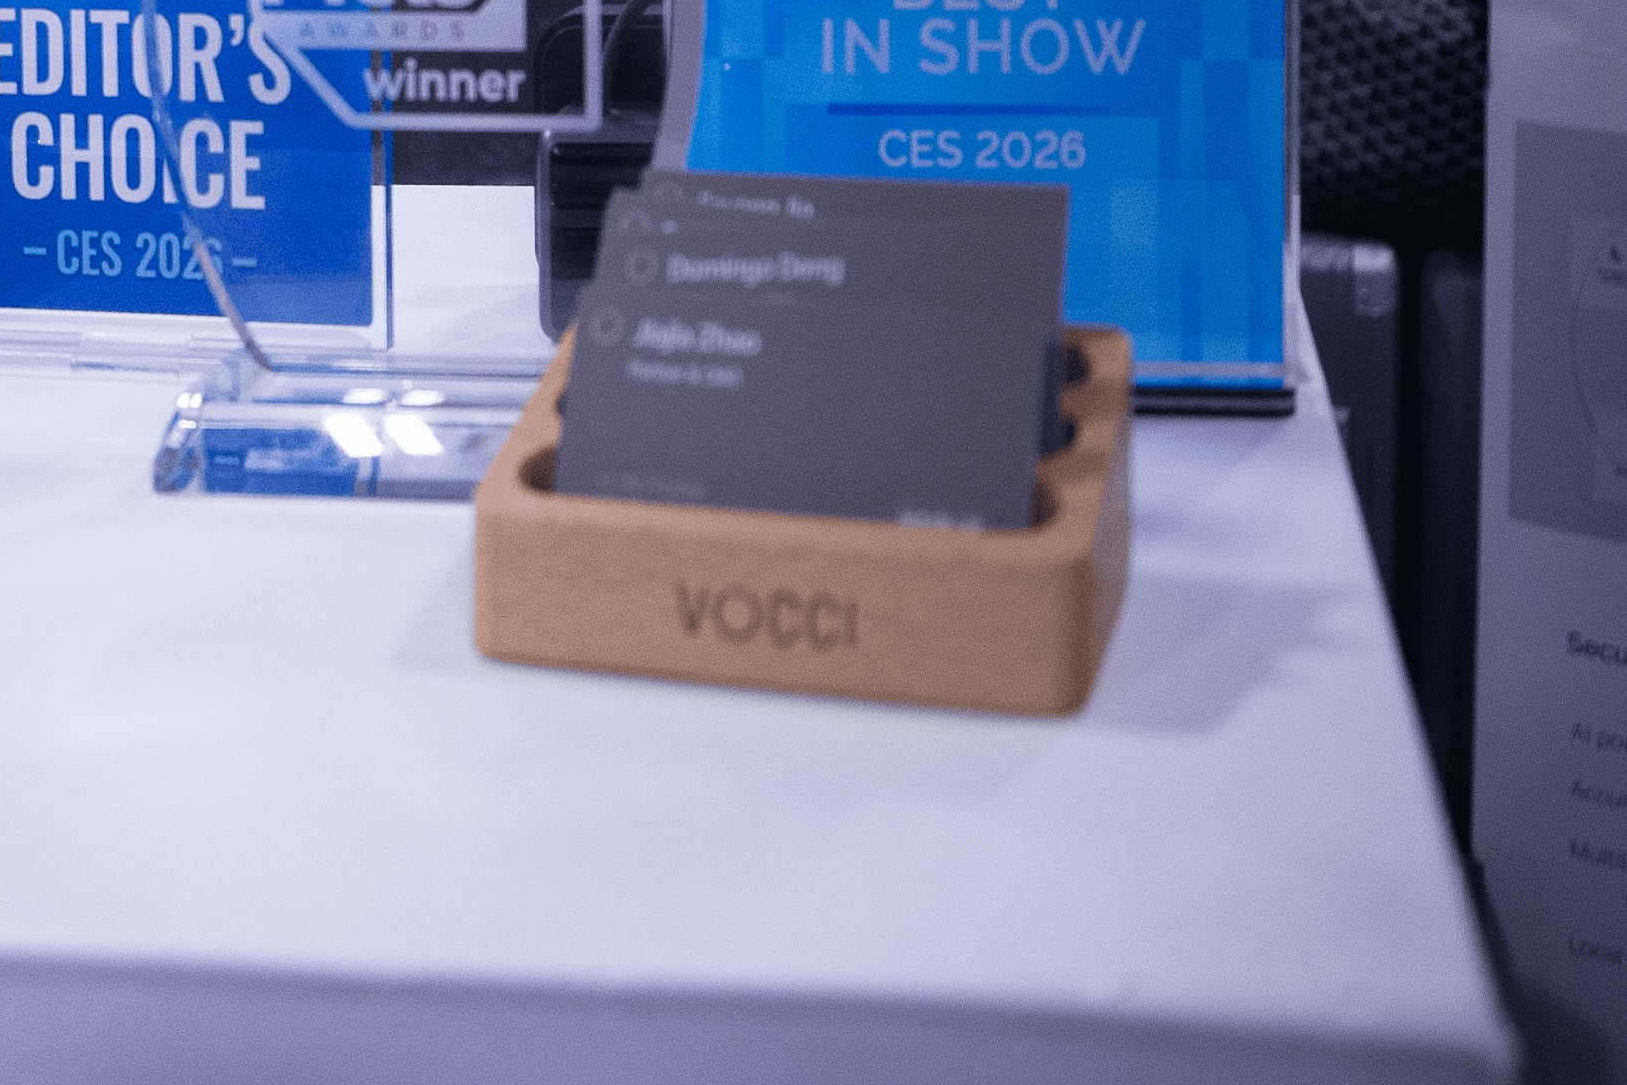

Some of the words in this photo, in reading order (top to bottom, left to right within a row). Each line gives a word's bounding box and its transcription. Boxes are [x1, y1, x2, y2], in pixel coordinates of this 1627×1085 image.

[821, 17, 892, 75] IN
[918, 17, 1146, 76] SHOW
[362, 57, 526, 103] winner
[878, 128, 964, 169] CES
[974, 129, 1087, 170] 2026
[56, 229, 123, 278] CES
[677, 581, 860, 652] VOCCI
